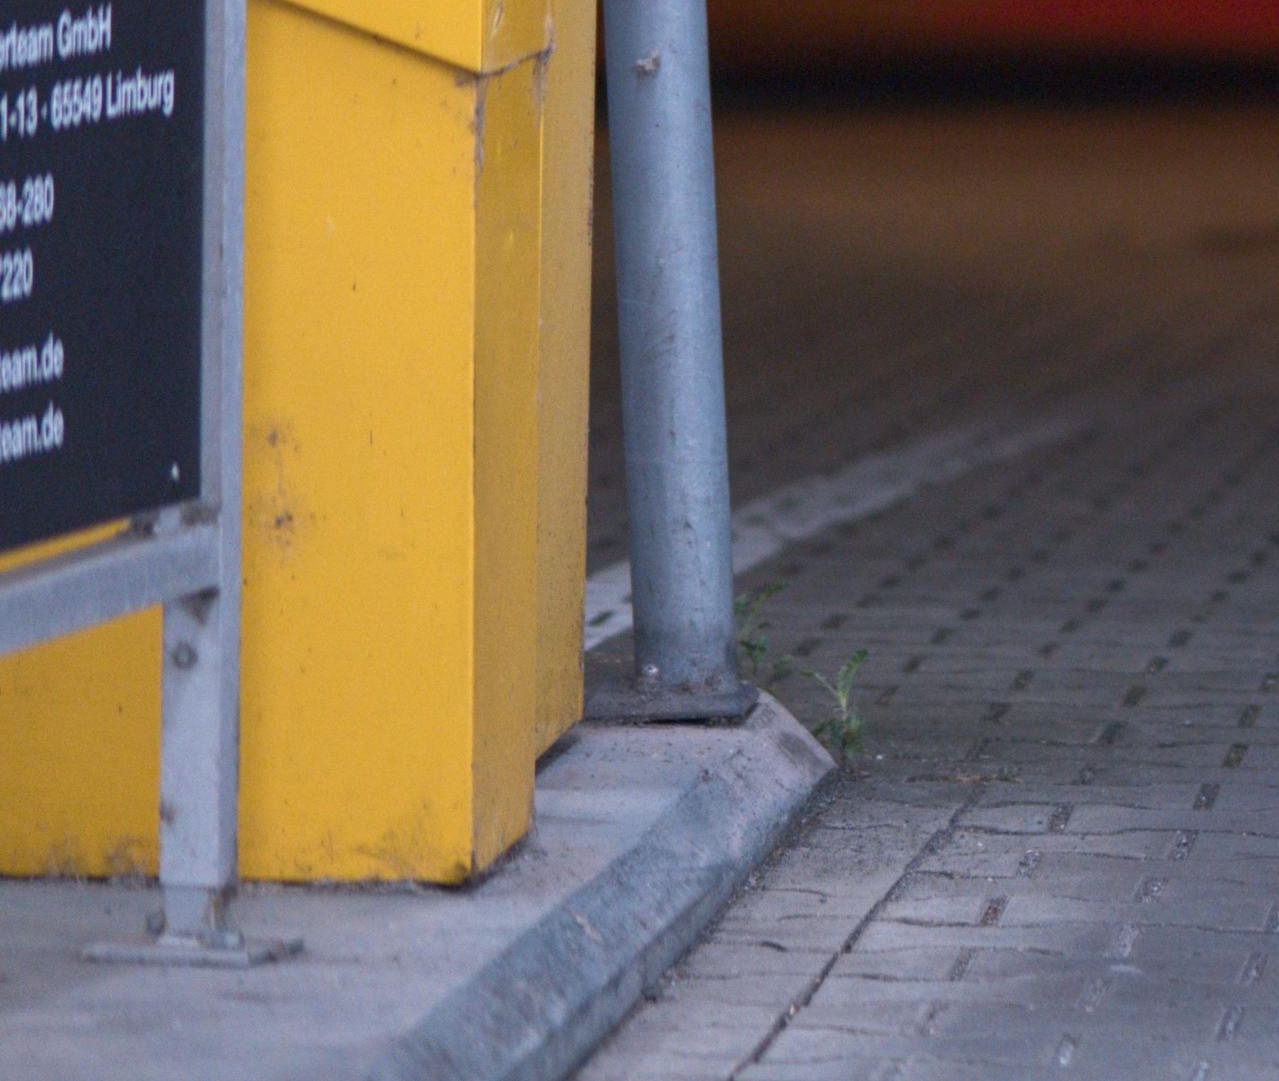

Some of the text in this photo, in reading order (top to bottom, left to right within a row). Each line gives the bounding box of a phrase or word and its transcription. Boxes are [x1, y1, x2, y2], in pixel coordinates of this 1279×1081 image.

[57, 3, 111, 59] GmbH
[51, 74, 103, 131] 65549
[106, 66, 175, 117] Limburg
[0, 248, 33, 302] 220
[0, 332, 64, 393] eam.de
[0, 401, 64, 463] eam.de
